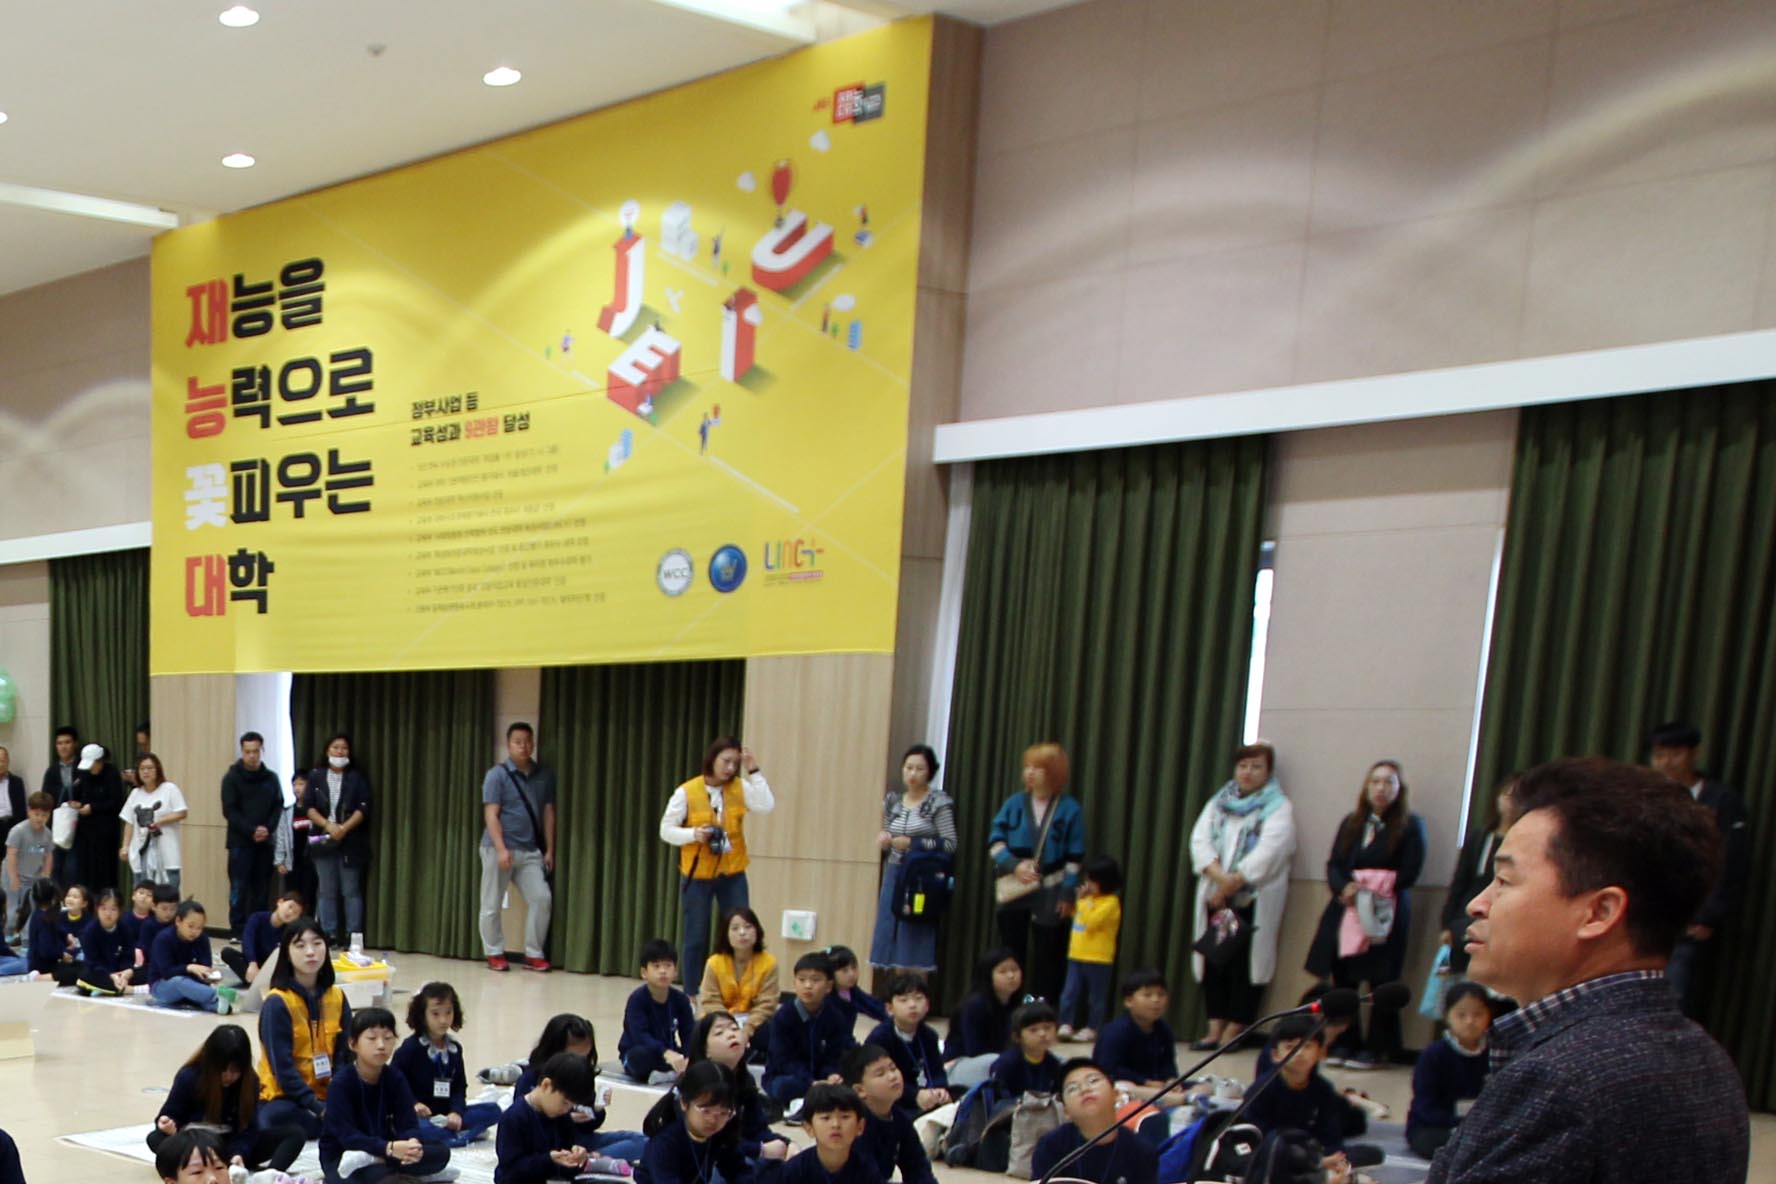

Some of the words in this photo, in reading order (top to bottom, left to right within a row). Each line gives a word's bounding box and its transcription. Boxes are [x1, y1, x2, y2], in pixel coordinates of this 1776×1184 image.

[185, 257, 325, 348] 재능을
[185, 346, 375, 440] 능력으로
[412, 394, 462, 419] 정부사업
[410, 422, 461, 446] 교육성과
[503, 411, 530, 434] 달성
[184, 448, 374, 531] 꽃피우는
[185, 548, 274, 617] 대학
[663, 567, 689, 580] WCC
